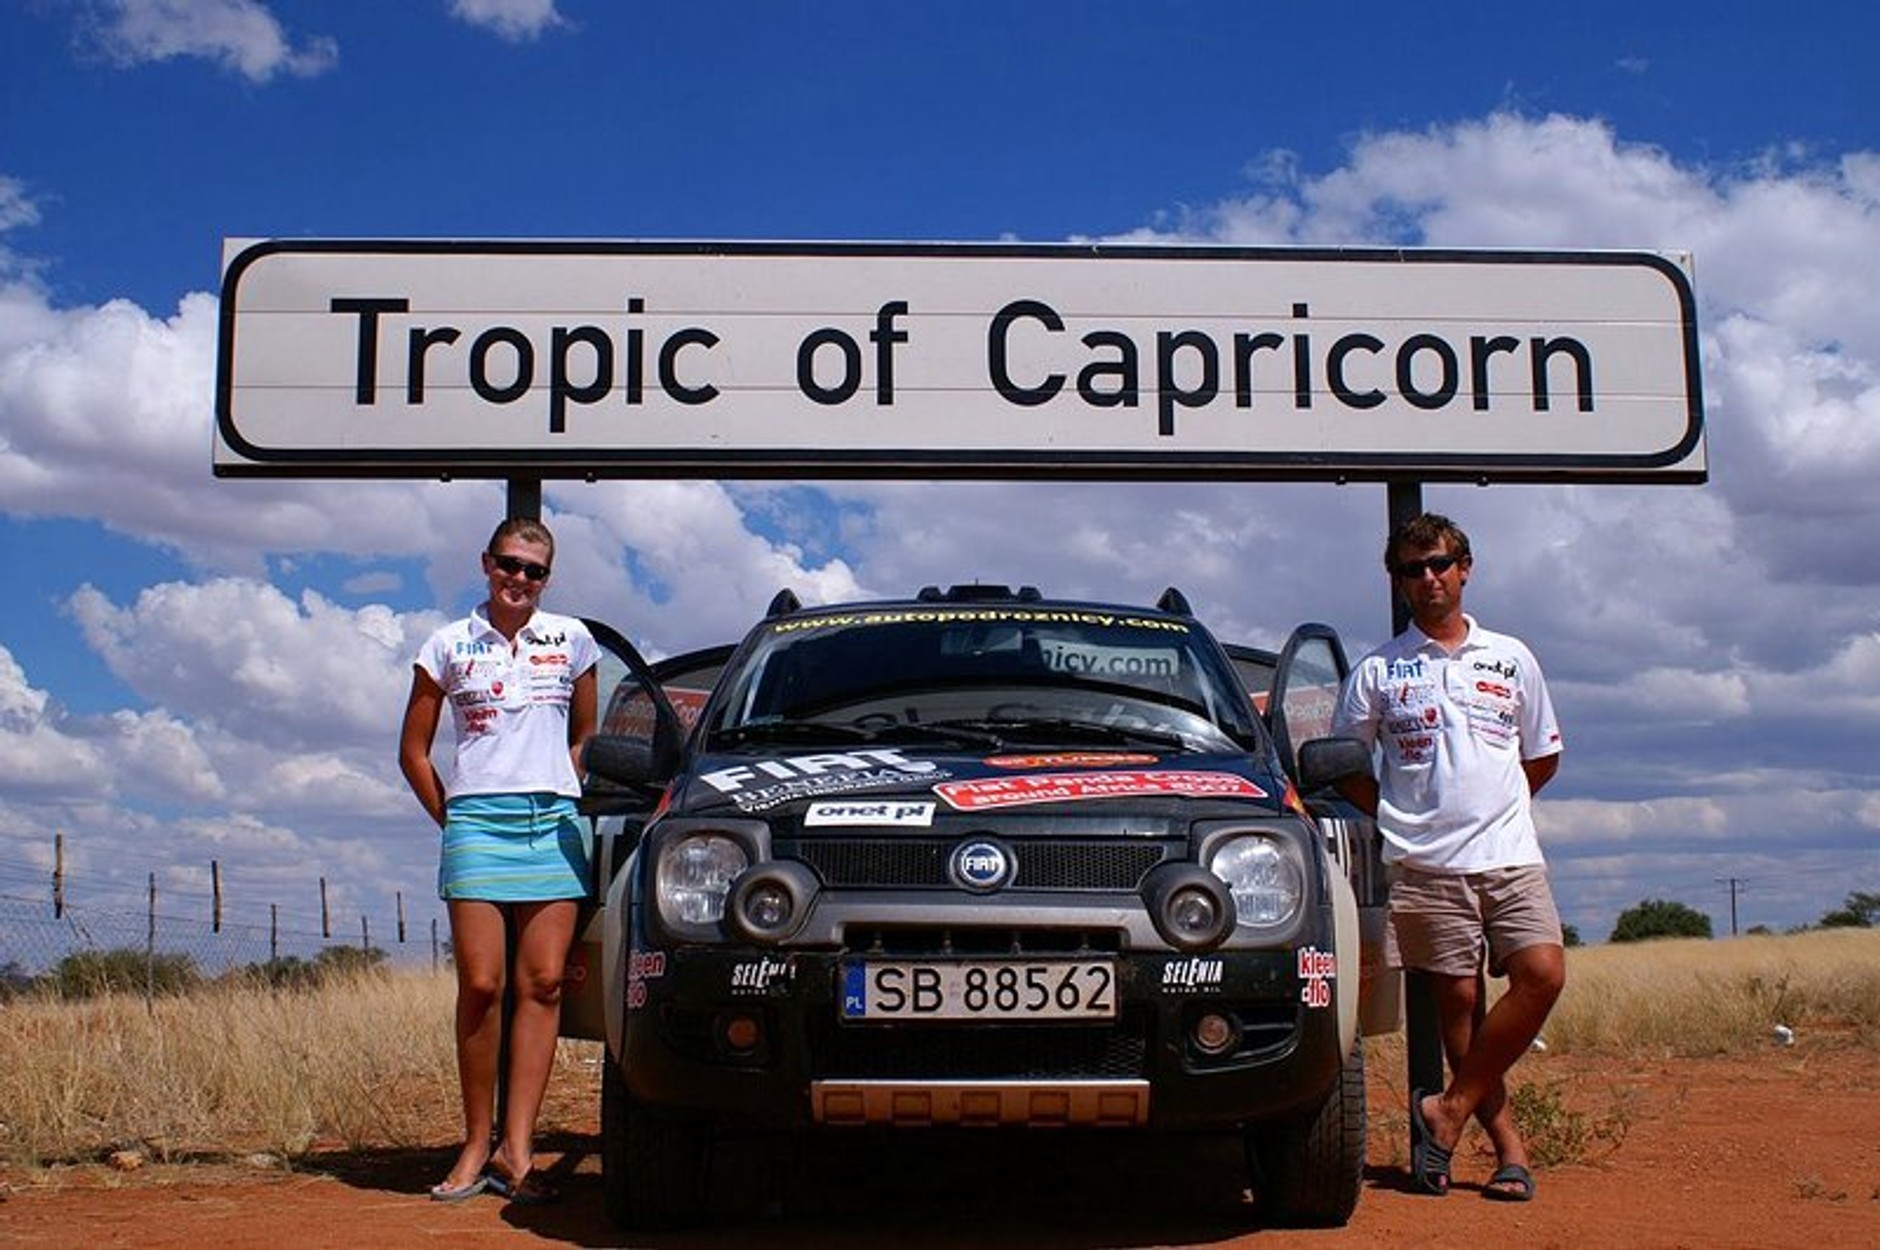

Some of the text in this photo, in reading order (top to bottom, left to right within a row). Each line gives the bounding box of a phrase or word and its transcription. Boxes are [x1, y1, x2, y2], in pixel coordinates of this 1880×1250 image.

[330, 297, 1595, 435] Tropic of Capricorn
[1387, 660, 1422, 679] FIAT
[700, 749, 937, 793] FIAT
[965, 856, 1000, 871] FIAT
[1162, 956, 1224, 986] SELENIA
[845, 996, 863, 1010] PL
[875, 966, 1111, 1012] SB 88562
